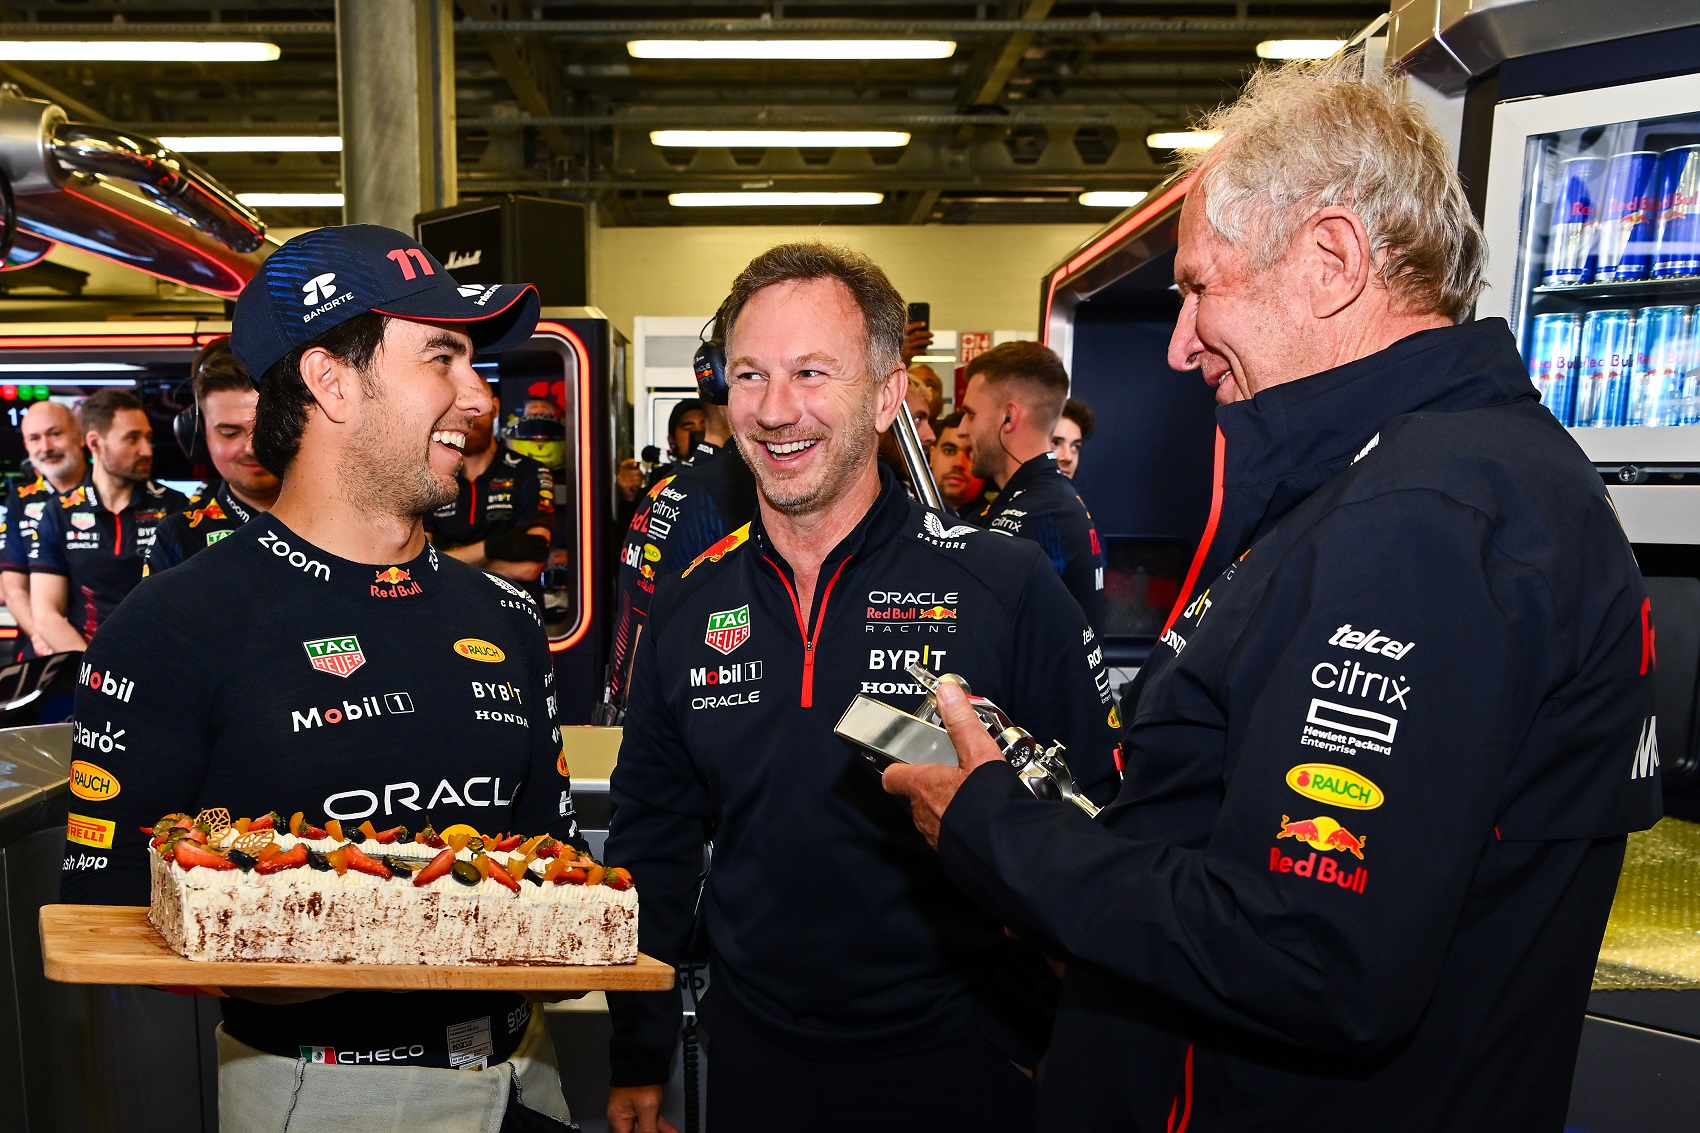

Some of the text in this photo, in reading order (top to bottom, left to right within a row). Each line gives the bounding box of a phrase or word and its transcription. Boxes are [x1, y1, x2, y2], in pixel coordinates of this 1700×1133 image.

[386, 248, 434, 281] 11
[303, 291, 355, 323] BANORTE
[660, 487, 688, 502] telcel
[226, 494, 250, 523] zoom
[652, 501, 681, 522] citrix
[991, 517, 1023, 533] citrix
[916, 532, 967, 550] CASTORE
[257, 530, 331, 582] zoom
[370, 582, 423, 599] Red Bull
[868, 591, 959, 605] ORACLE
[500, 599, 542, 627] CASTORE
[713, 608, 749, 628] TAG
[866, 606, 916, 620] Red Bull
[707, 626, 749, 651] HEUER
[865, 625, 957, 634] RACING
[308, 637, 356, 655] TAG
[467, 644, 500, 658] RAUCH
[1328, 623, 1416, 661] telcel
[313, 654, 363, 677] HEUER
[869, 645, 946, 671] BYBIT
[78, 661, 136, 703] Mobil
[690, 664, 742, 687] Mobil
[1311, 659, 1411, 711] citrix
[471, 681, 523, 705] BYBIT
[691, 691, 761, 710] ORACLE
[291, 695, 382, 733] Mobil
[474, 710, 530, 729] HONDA
[1300, 735, 1357, 756] Enterprise
[1303, 725, 1392, 756] Hewlett Packard
[74, 769, 111, 795] RAUCH
[1312, 773, 1372, 804] RAUCH
[323, 775, 523, 821] ORACL
[75, 852, 109, 872] App
[1269, 847, 1369, 895] Red Bull
[338, 1044, 425, 1065] CHECO
